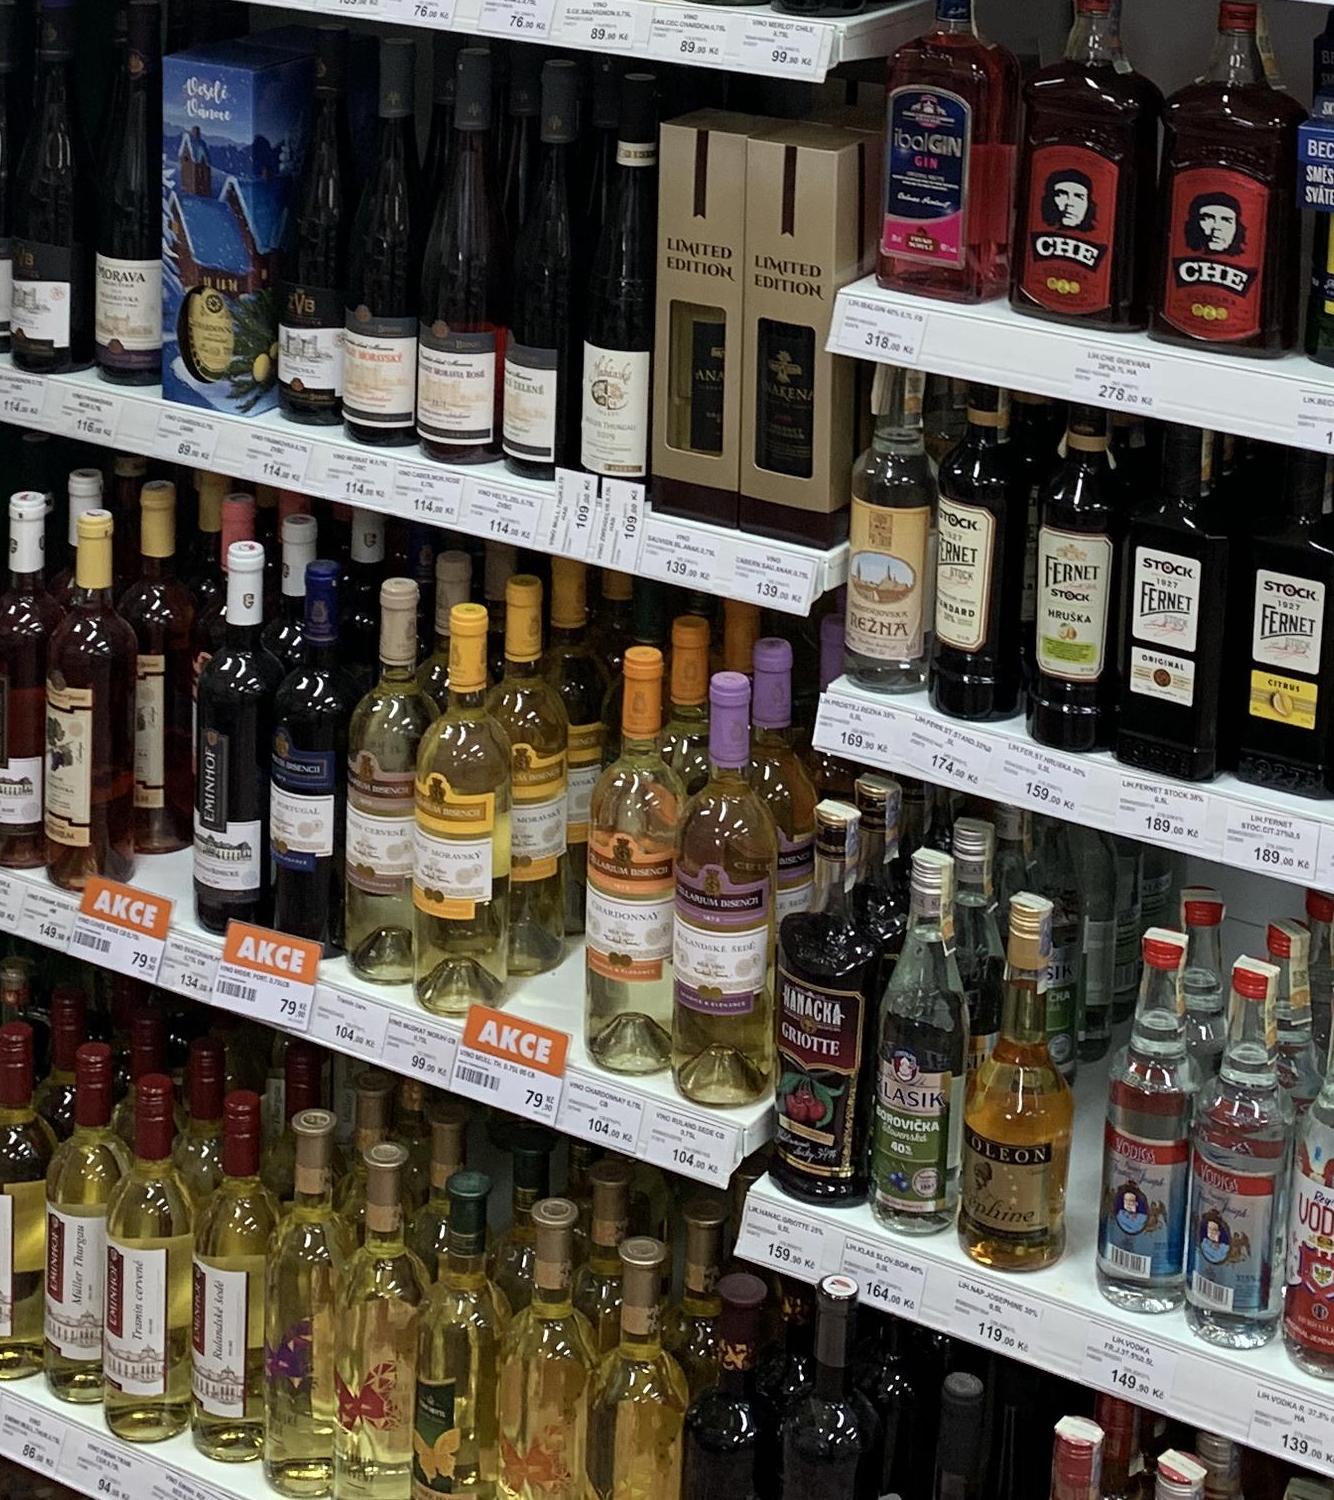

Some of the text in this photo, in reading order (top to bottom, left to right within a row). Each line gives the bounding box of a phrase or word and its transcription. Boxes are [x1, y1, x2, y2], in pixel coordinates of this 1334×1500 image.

[914, 156, 939, 169] GIN
[1305, 165, 1330, 185] SMĚS
[667, 238, 732, 259] LIMITED
[1035, 236, 1100, 266] CHE
[98, 268, 146, 284] MORAVA
[667, 258, 734, 281] EDITION
[755, 255, 822, 277] LIMITED
[1179, 261, 1248, 291] CHE
[755, 275, 824, 299] EDITION
[1045, 556, 1101, 589] FERNET
[1142, 557, 1195, 578] STOCK
[1156, 578, 1179, 589] 1927
[1263, 580, 1316, 601] STOCK
[1051, 588, 1090, 602] STOCK
[1140, 582, 1193, 617] FERNET
[1047, 608, 1091, 624] HRUŠKA
[1260, 606, 1314, 640] FERNET
[1141, 653, 1185, 671] ORIGINAL
[1268, 678, 1300, 693] CITRUS
[94, 890, 157, 928] AKCE
[237, 934, 305, 973] AKCE
[478, 1019, 553, 1064] AKCE
[781, 1019, 840, 1056] GRIOTTE
